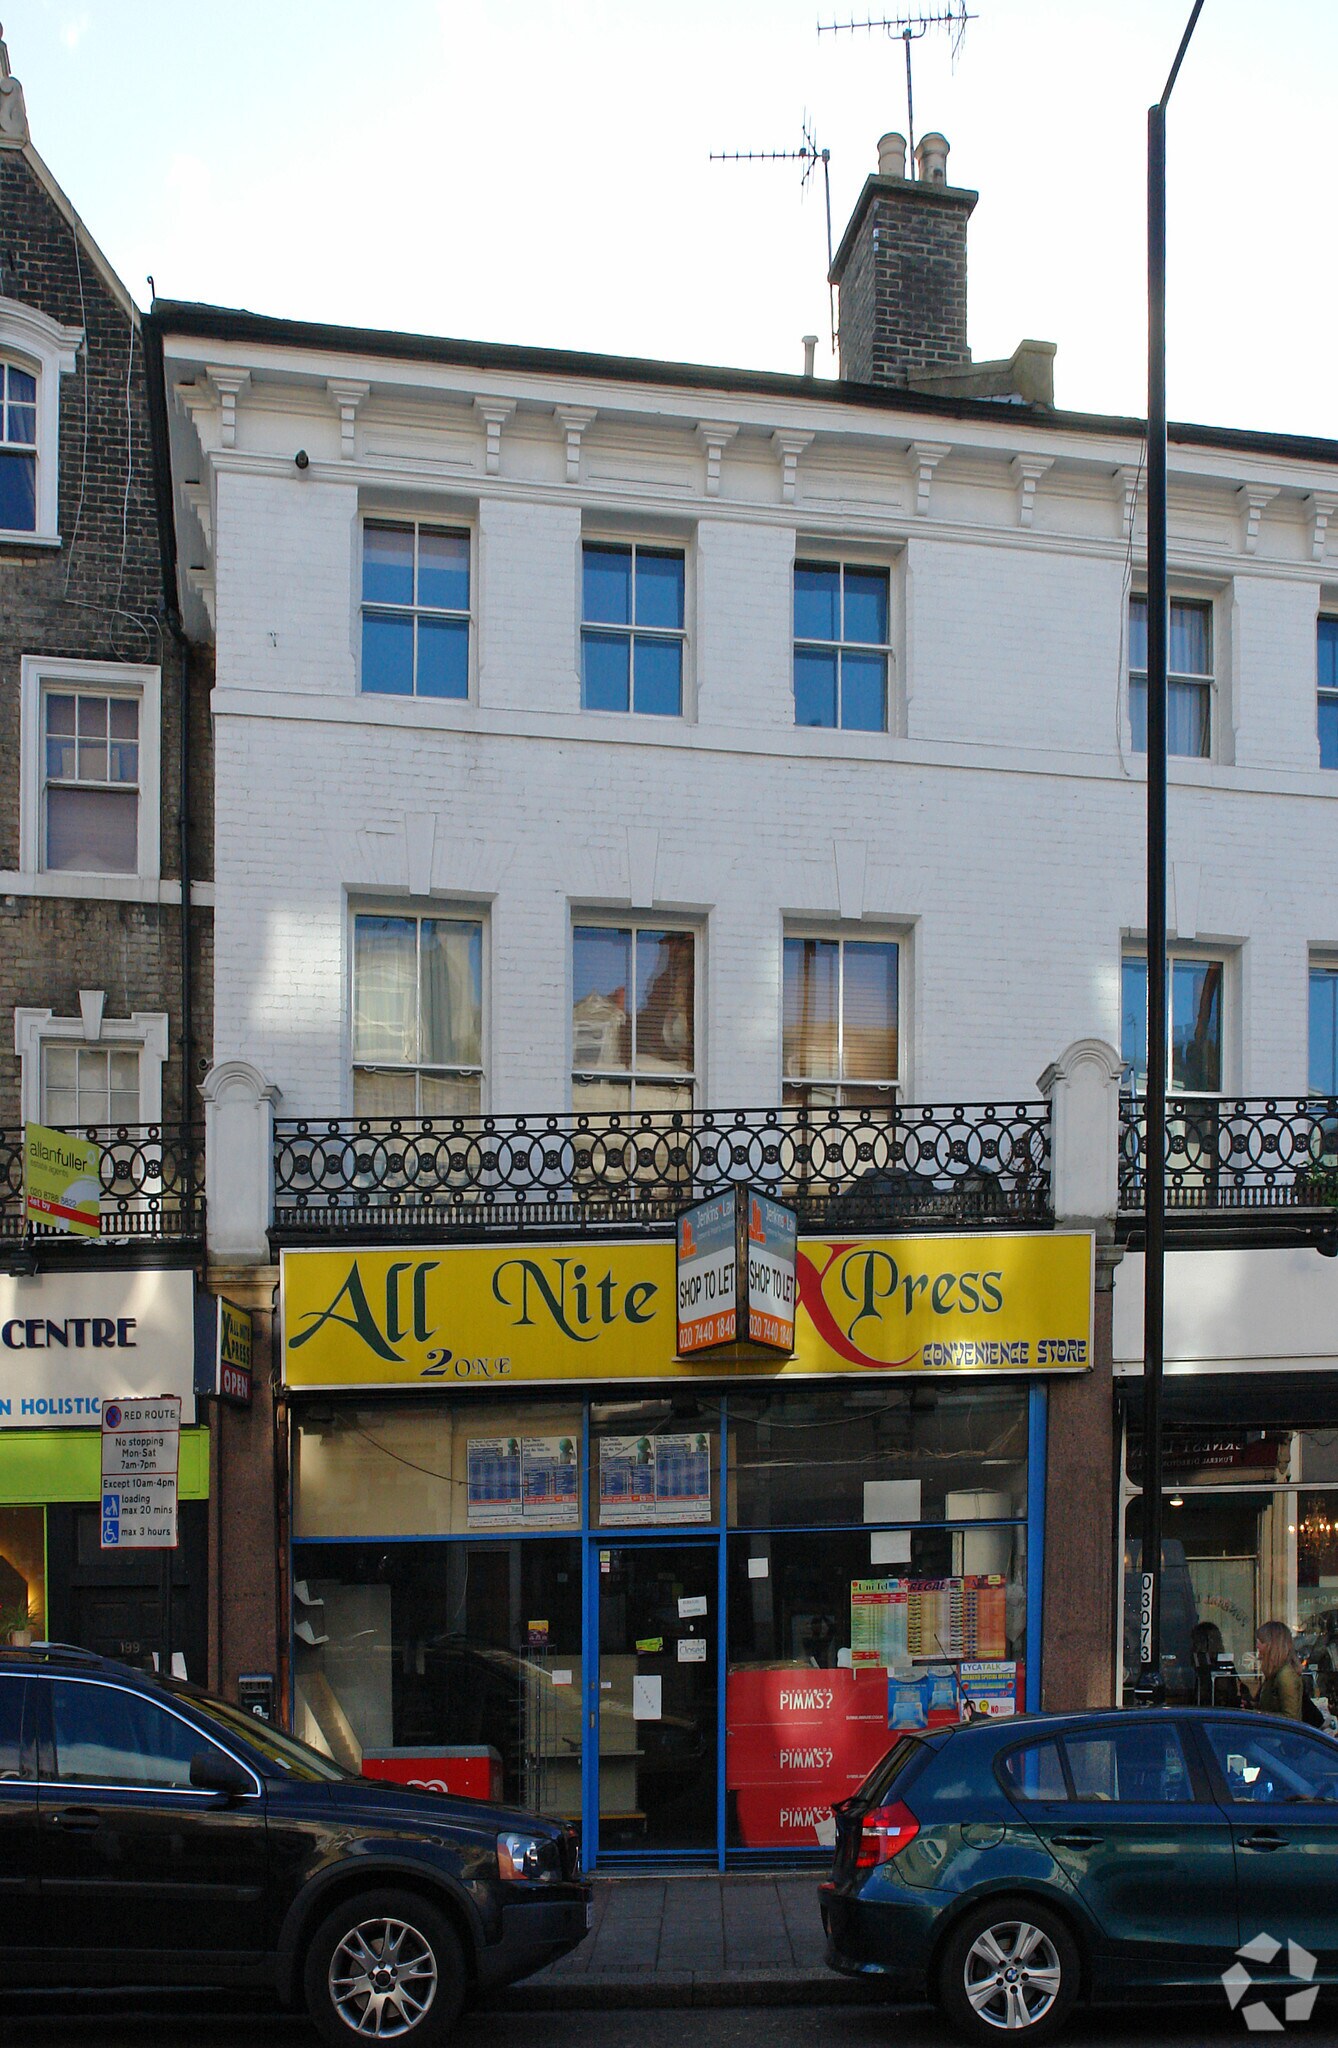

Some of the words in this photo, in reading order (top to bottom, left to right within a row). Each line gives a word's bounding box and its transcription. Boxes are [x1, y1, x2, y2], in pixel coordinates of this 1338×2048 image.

[30, 1141, 88, 1171] allanfuller
[48, 1166, 68, 1178] agents
[30, 1186, 42, 1198] 020
[42, 1200, 51, 1211] by
[696, 1205, 719, 1228] Jenkins
[766, 1203, 784, 1228] Jenkins
[680, 1275, 700, 1310] SHOP
[704, 1270, 716, 1300] TO
[718, 1262, 735, 1296] LET
[750, 1260, 770, 1293] SHOP
[772, 1270, 782, 1298] TO
[783, 1274, 794, 1304] LET
[288, 1259, 440, 1362] All
[492, 1258, 659, 1342] Nite
[1, 1317, 137, 1350] CENTRE
[680, 1326, 692, 1349] 020
[695, 1319, 714, 1344] 7440
[716, 1313, 736, 1338] 1840
[750, 1314, 762, 1336] 020
[763, 1318, 778, 1342] 7440
[780, 1324, 793, 1347] 1840
[232, 1339, 250, 1365] PRESS
[922, 1340, 1030, 1366] CONVENIENCE
[1037, 1339, 1087, 1364] STORE
[224, 1369, 248, 1399] OPEN
[21, 1396, 101, 1415] HOLISTIC
[124, 1410, 141, 1420] RED
[145, 1408, 175, 1420] ROUTE
[115, 1437, 126, 1447] No
[128, 1436, 164, 1450] stopping
[122, 1448, 156, 1458] Mon-Sat
[120, 1460, 156, 1470] 7am-7pm
[103, 1478, 130, 1489] Except
[132, 1478, 175, 1489] 10am-4pm
[121, 1494, 150, 1505] loading
[121, 1506, 137, 1514] max
[140, 1504, 151, 1514] 20
[154, 1505, 172, 1514] mins
[121, 1528, 137, 1536] max
[140, 1526, 145, 1536] 3
[147, 1525, 170, 1536] hours
[910, 1580, 946, 1592] REGAL
[120, 1642, 140, 1653] 199
[780, 1693, 833, 1710] PIMM'S?
[991, 1704, 999, 1714] NO
[780, 1752, 833, 1769] PIMM'S?
